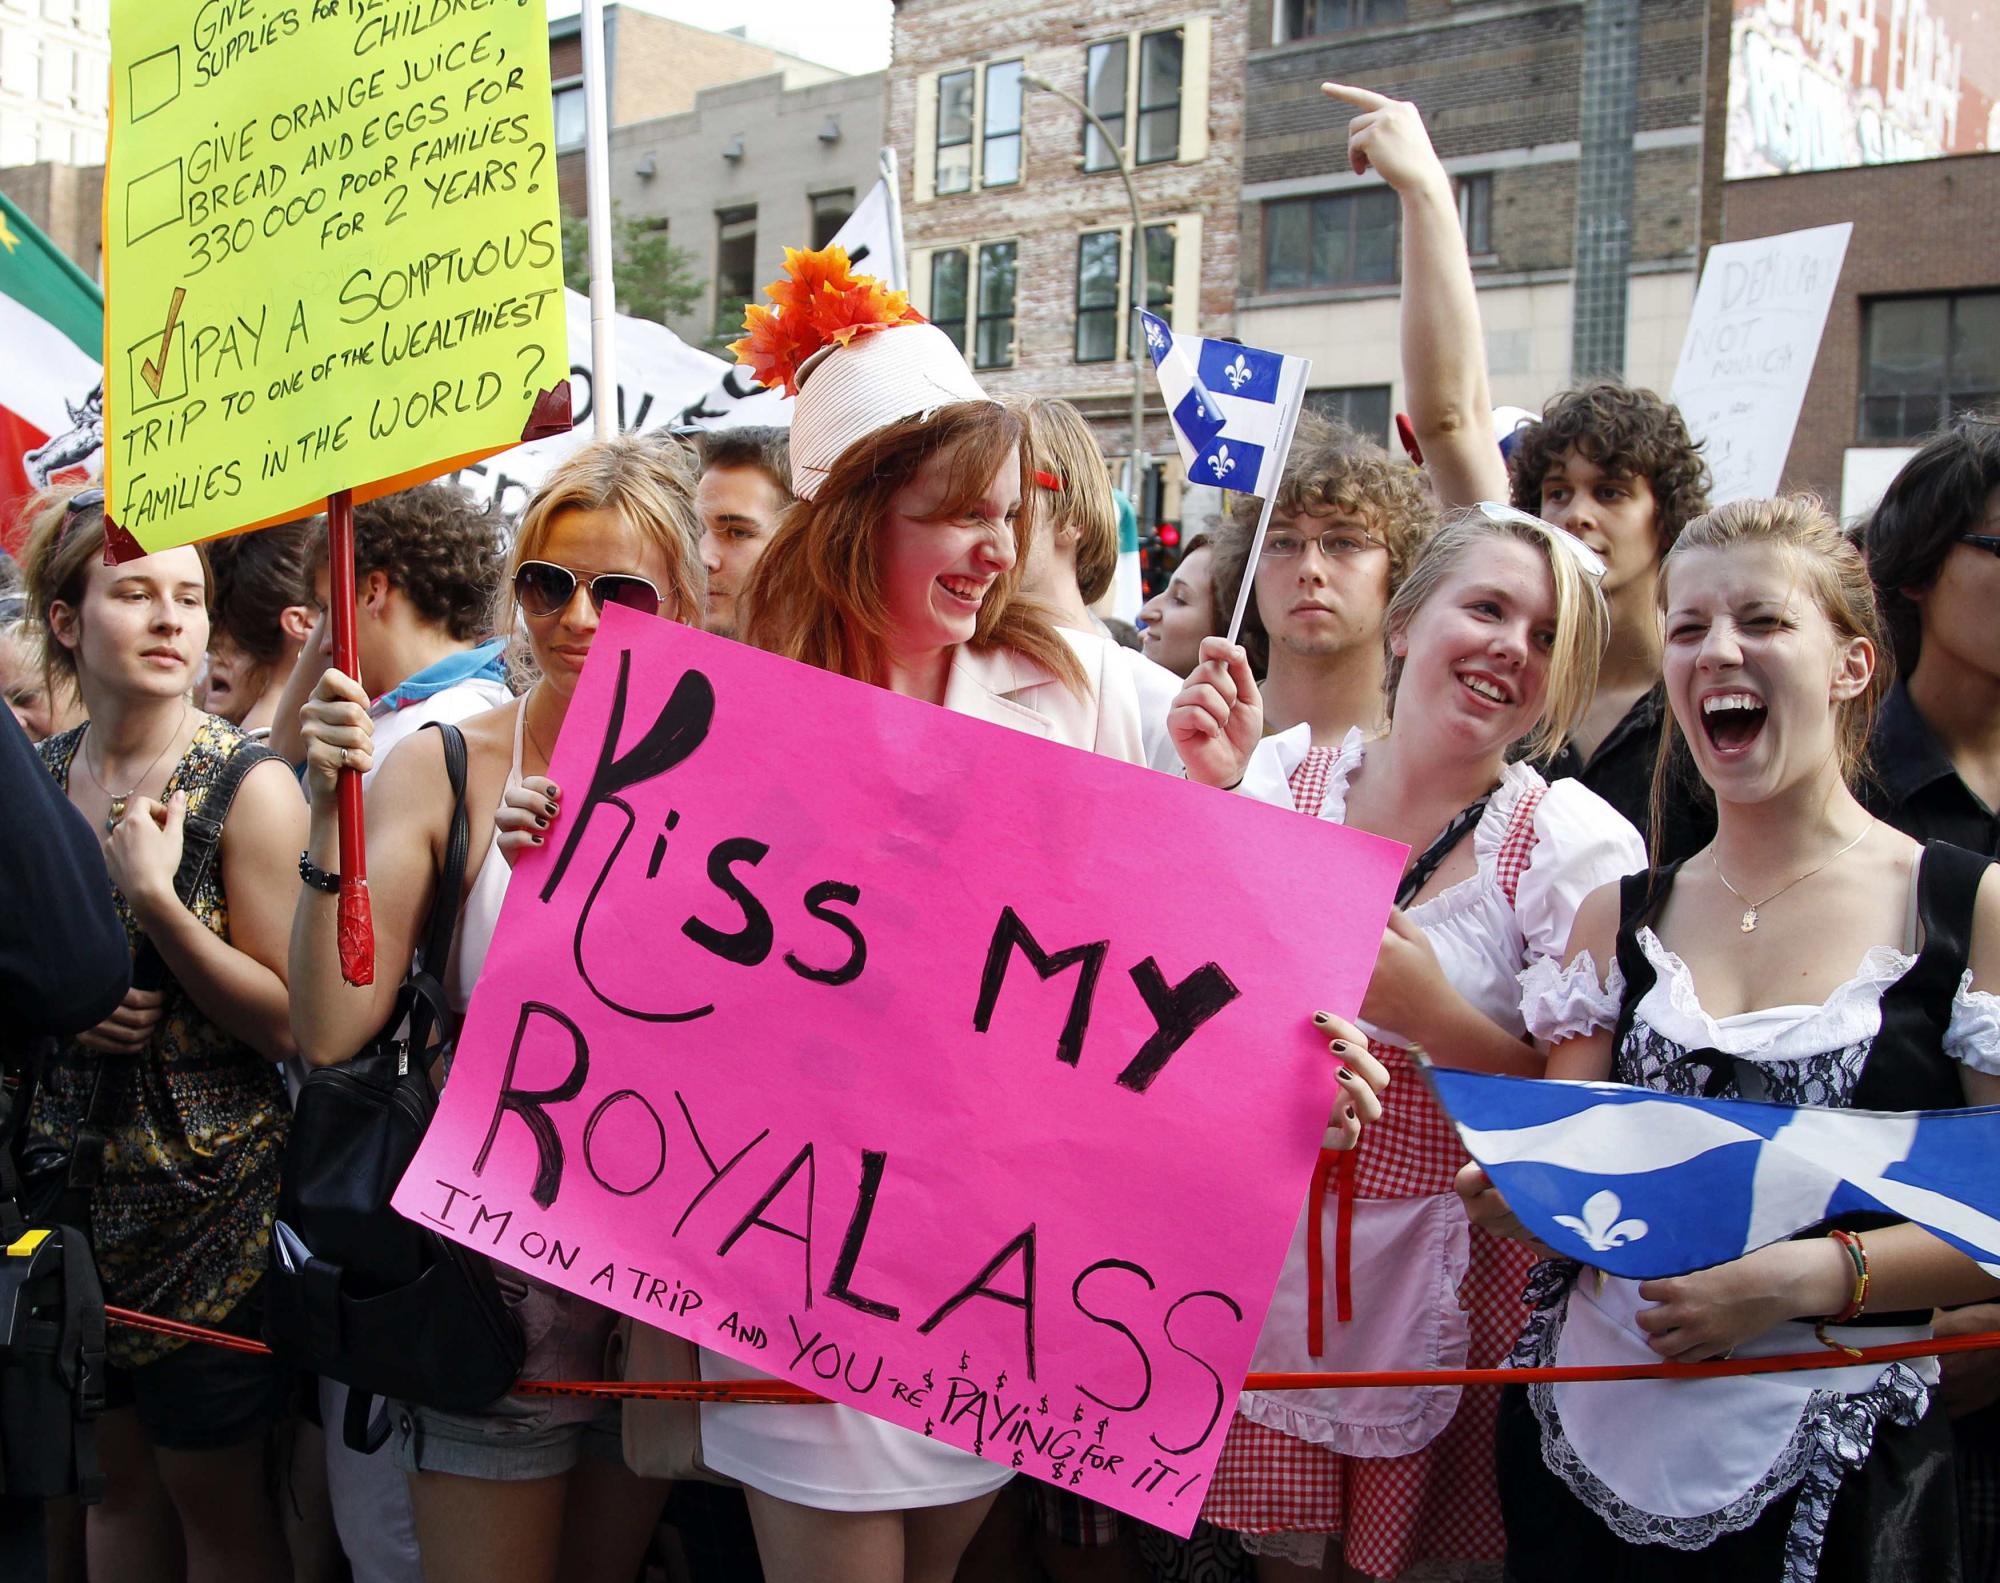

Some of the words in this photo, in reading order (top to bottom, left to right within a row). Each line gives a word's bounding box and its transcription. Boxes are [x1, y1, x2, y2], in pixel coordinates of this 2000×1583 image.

[188, 120, 256, 184] GIVE
[270, 69, 384, 142] ORANGE
[395, 31, 505, 90] JUICE,
[194, 9, 299, 87] SUPPLIES
[312, 0, 339, 25] FOR
[189, 164, 286, 227] BREAD
[301, 133, 353, 176] AND
[362, 95, 449, 146] EGGS
[465, 67, 524, 113] FOR
[320, 211, 363, 250] FOR
[384, 184, 407, 226] 2
[339, 156, 396, 201] POOR
[410, 114, 530, 172] FAMILIES
[122, 399, 207, 466] TRIP
[221, 390, 255, 421] TO
[268, 370, 303, 401] ONE
[311, 353, 337, 382] OF
[340, 340, 374, 366] THE
[381, 288, 558, 366] WEALTHIEST
[190, 304, 266, 383] PAY
[285, 299, 308, 353] A
[339, 220, 555, 325] SOMPTUOUS
[1687, 316, 1763, 362] NOT
[120, 460, 241, 528] FAMILIES
[262, 439, 287, 481] IN
[297, 416, 352, 462] THE
[973, 905, 1242, 1094] MY
[473, 1001, 899, 1321] ROYAL
[917, 1222, 1243, 1455] ASS
[420, 1180, 512, 1244] I'M
[520, 1232, 580, 1270] ON
[590, 1264, 613, 1292] A
[628, 1267, 703, 1316] TRIP
[718, 1312, 767, 1349] AND
[941, 1376, 1082, 1459] PAYING
[1080, 1444, 1124, 1474] FOR
[1132, 1459, 1201, 1506] IT!
